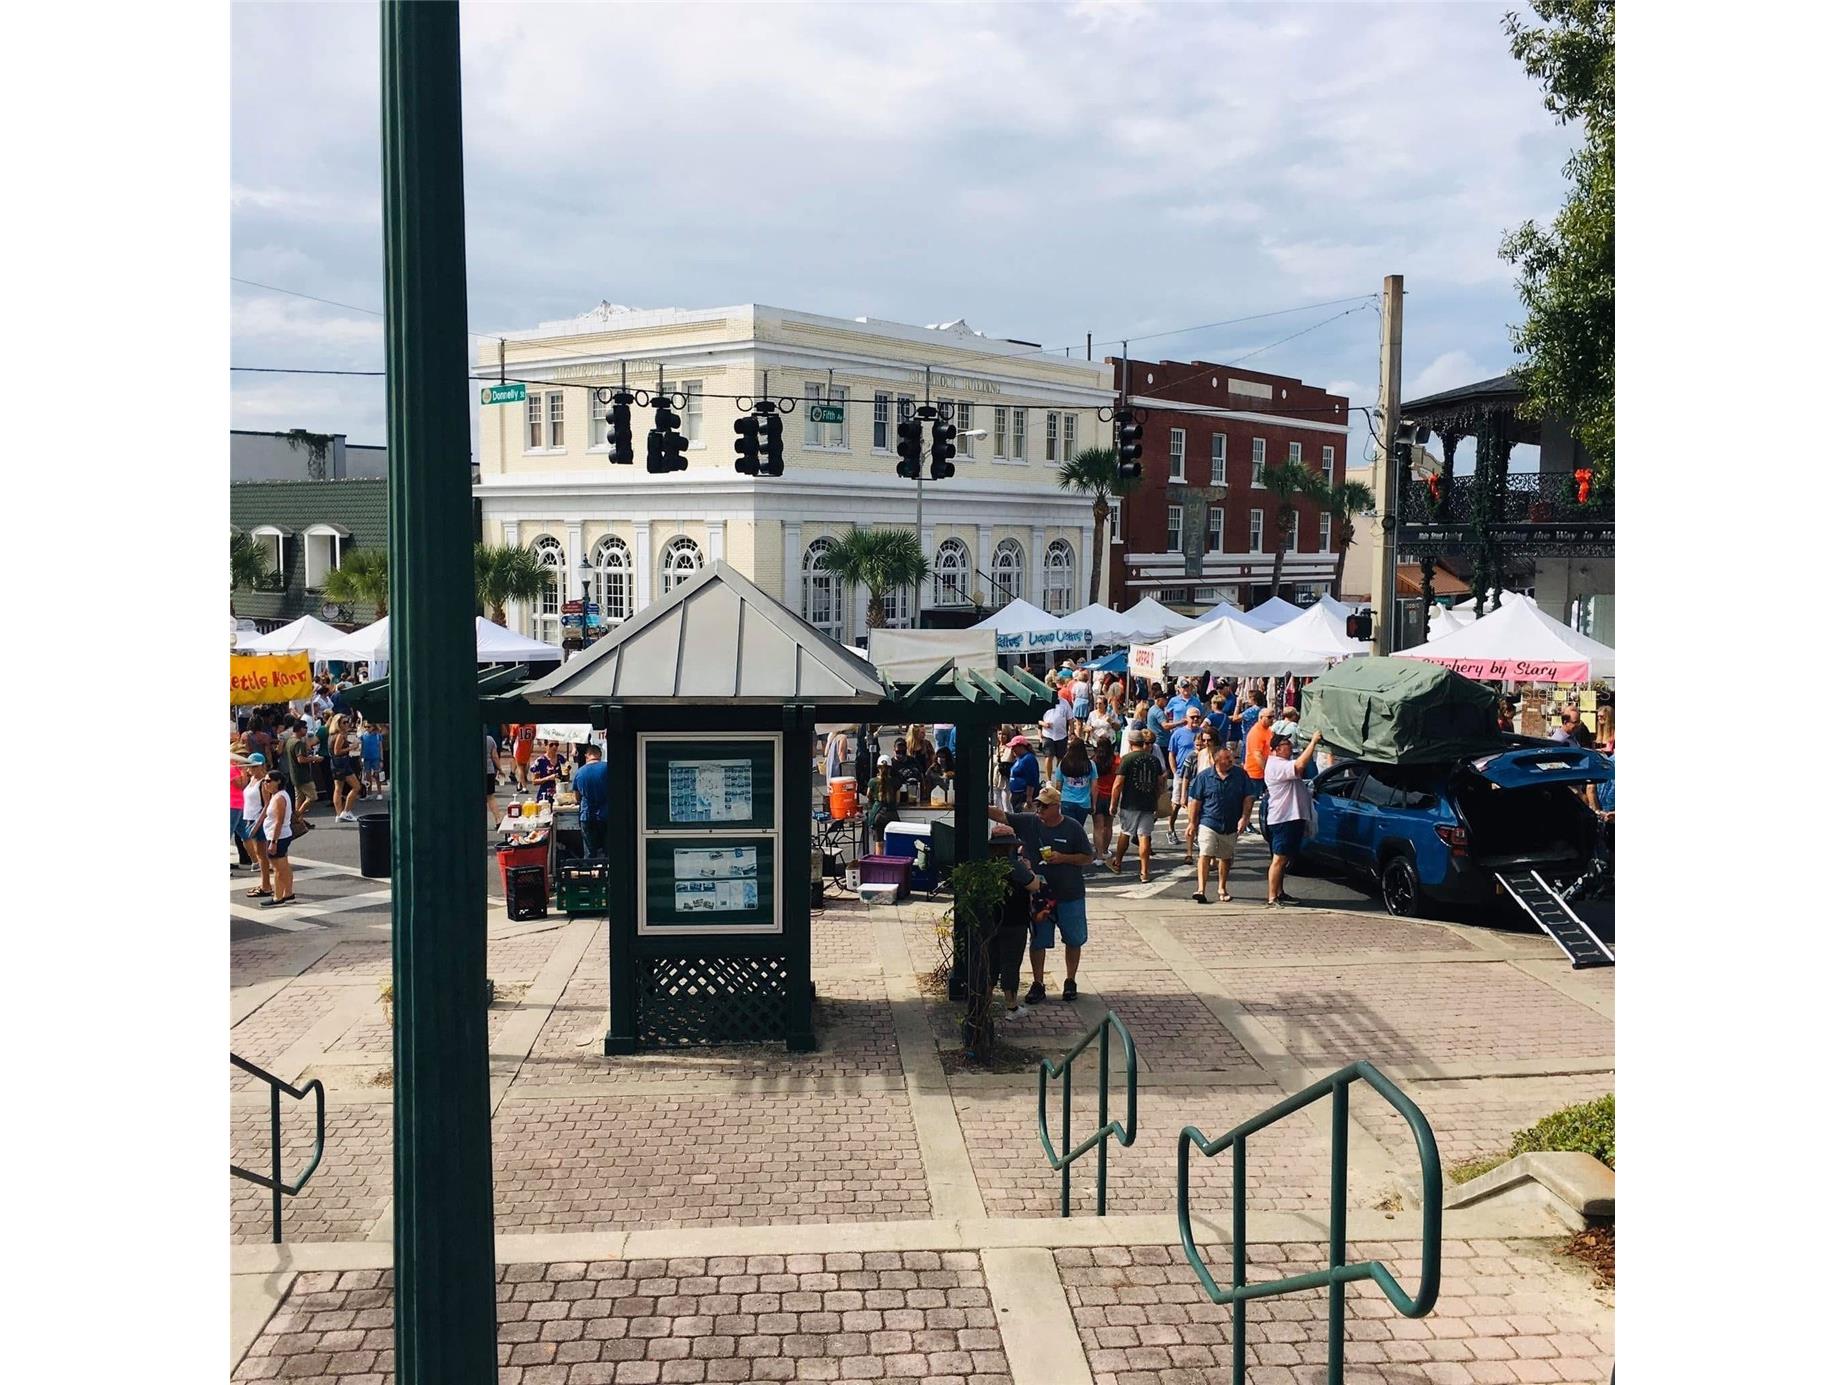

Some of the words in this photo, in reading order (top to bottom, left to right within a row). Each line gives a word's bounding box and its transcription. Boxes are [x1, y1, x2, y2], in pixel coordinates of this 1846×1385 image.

[492, 389, 519, 401] Donnelly
[1556, 530, 1577, 541] Way
[1490, 661, 1507, 678] by
[230, 671, 268, 691] ettle
